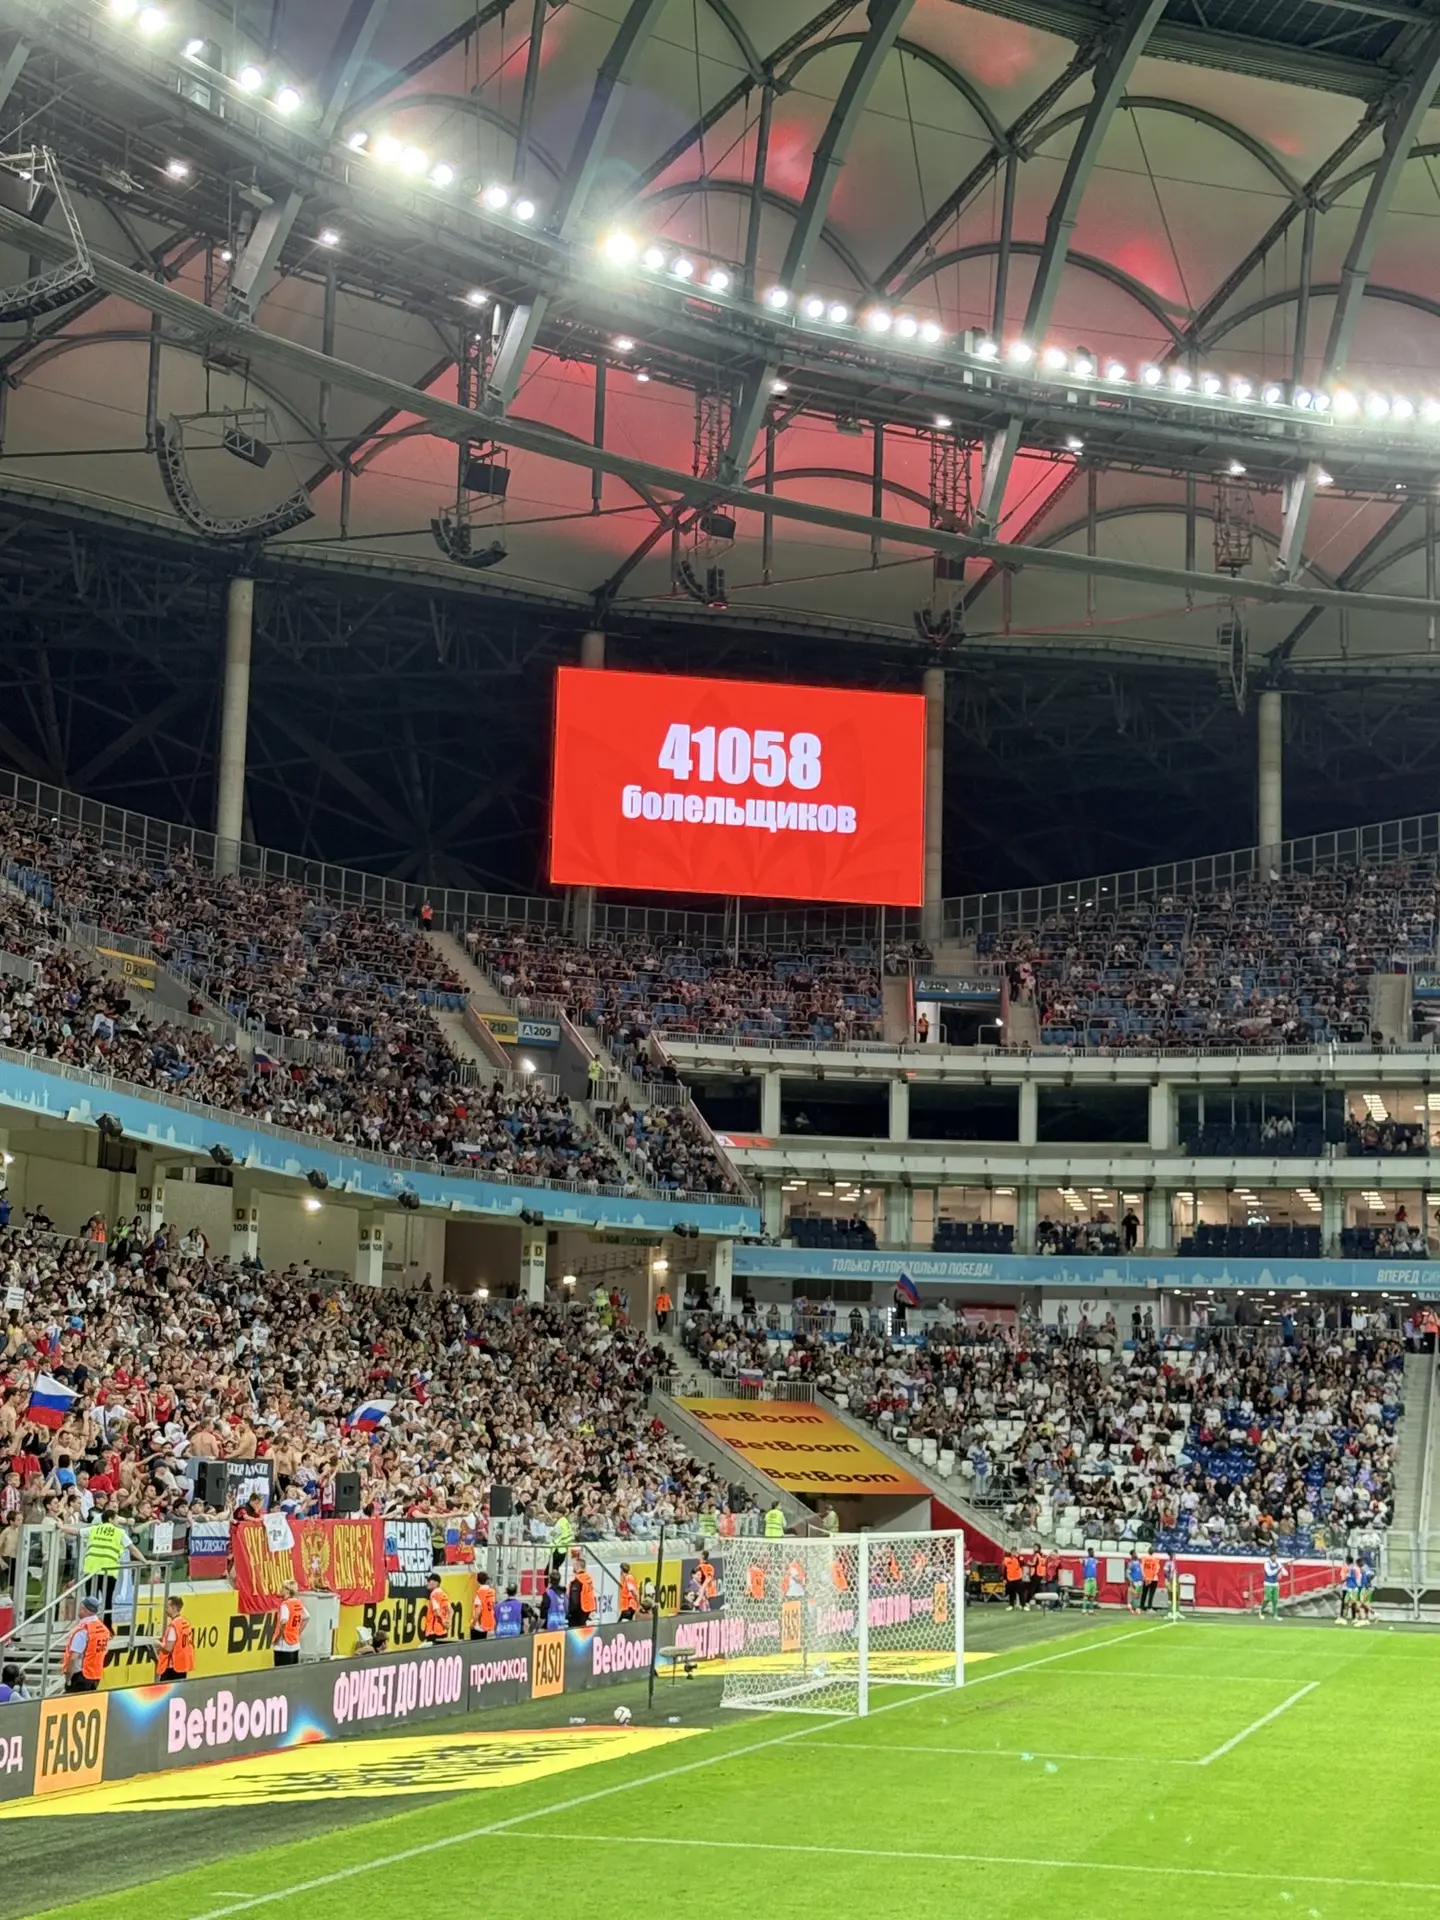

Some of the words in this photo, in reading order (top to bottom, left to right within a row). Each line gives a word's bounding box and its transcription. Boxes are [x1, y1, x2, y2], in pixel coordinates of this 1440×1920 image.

[658, 723, 822, 790] 41058
[622, 785, 857, 833] болельщиков
[491, 1022, 508, 1034] 210
[534, 1026, 552, 1037] 209
[233, 1223, 248, 1232] 108
[236, 1208, 245, 1220] D
[832, 1258, 871, 1272] ТОЛЬКО
[908, 1261, 946, 1275] ТОЛЬКО
[947, 1262, 993, 1277] ПОБЕДА!
[1376, 1269, 1420, 1284] ВПЕРЕД
[690, 1409, 823, 1424] BetBoom
[723, 1438, 861, 1453] BetBoom
[759, 1467, 900, 1483] BetBoom
[363, 1600, 464, 1645] BetBom
[535, 1642, 562, 1686] FASO
[592, 1633, 653, 1676] BetBoom
[470, 1657, 528, 1693] промокод
[333, 1665, 397, 1724] ФРИБЕТ
[394, 1661, 418, 1718] ДО
[167, 1690, 288, 1754] BetBoom
[42, 1708, 101, 1777] FASO
